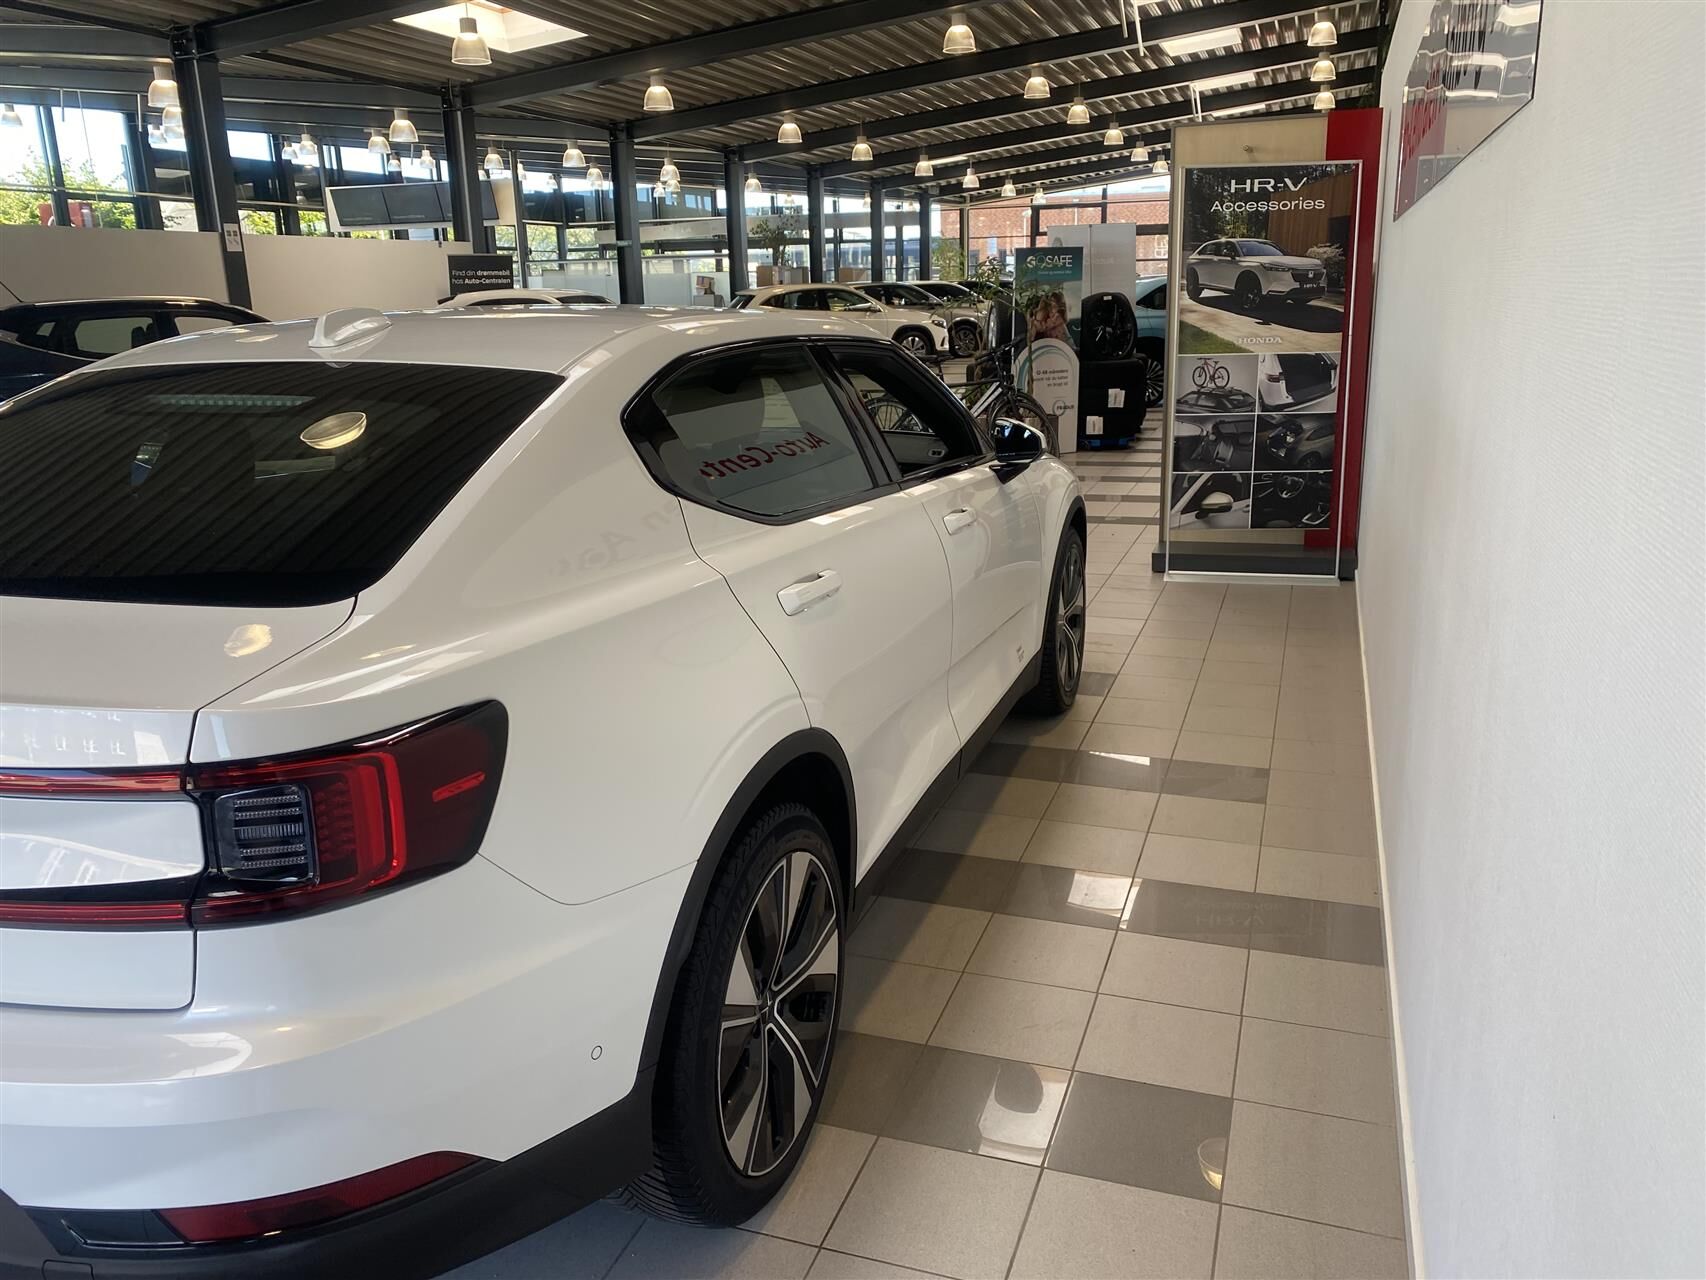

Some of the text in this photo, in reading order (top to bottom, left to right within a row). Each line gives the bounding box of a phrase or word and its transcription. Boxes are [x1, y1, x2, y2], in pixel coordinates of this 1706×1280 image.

[1230, 177, 1307, 193] HR-V
[1210, 196, 1326, 213] Accessories
[1239, 336, 1283, 344] HONDA
